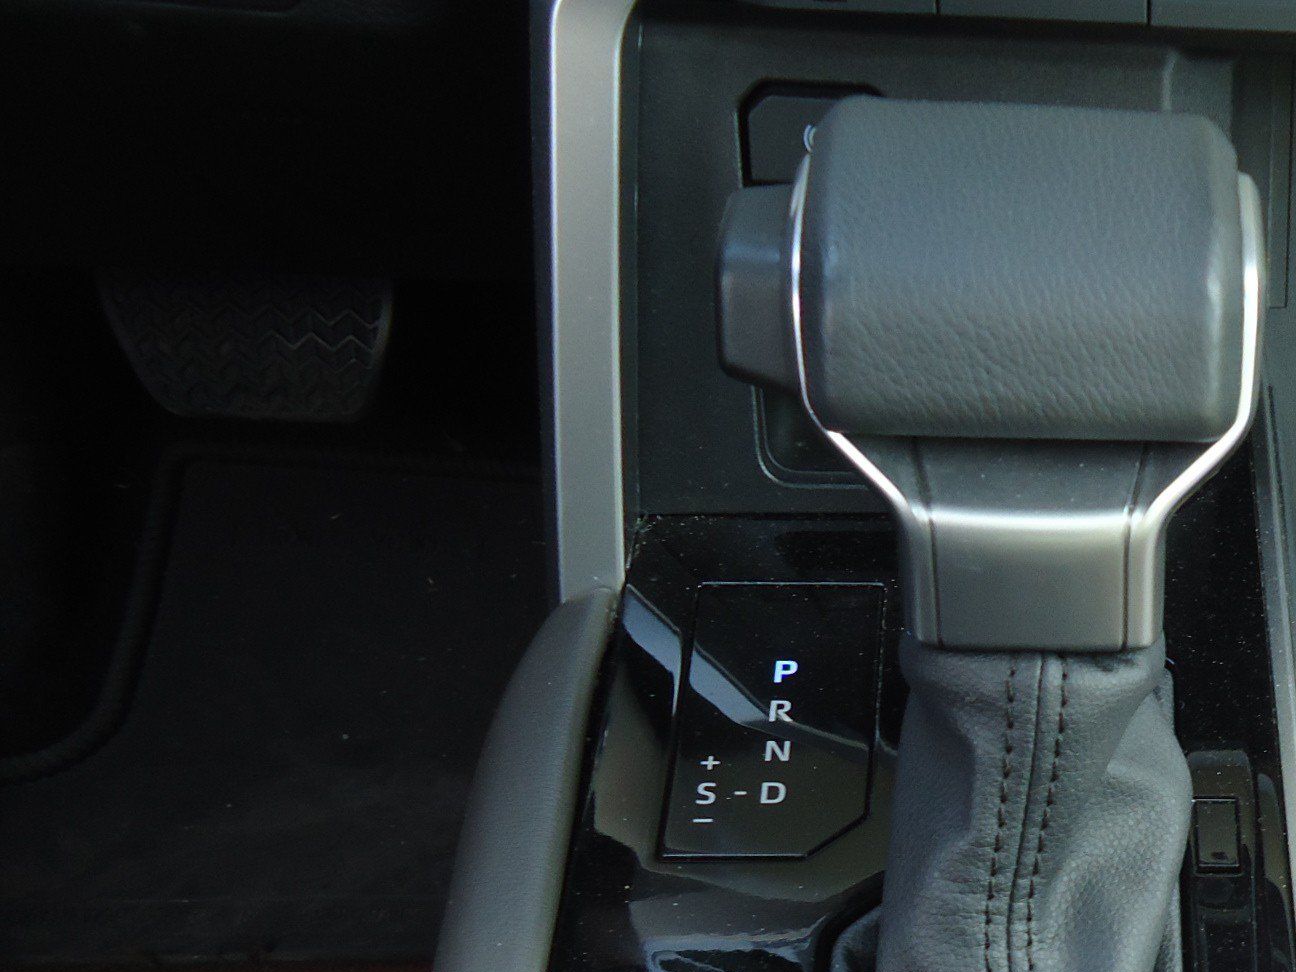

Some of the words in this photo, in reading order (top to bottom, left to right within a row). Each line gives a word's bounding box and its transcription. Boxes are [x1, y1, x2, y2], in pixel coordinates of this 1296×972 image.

[773, 660, 798, 683] P
[768, 700, 793, 722] R
[764, 740, 791, 762] N
[695, 782, 717, 805] S
[760, 781, 787, 804] D
